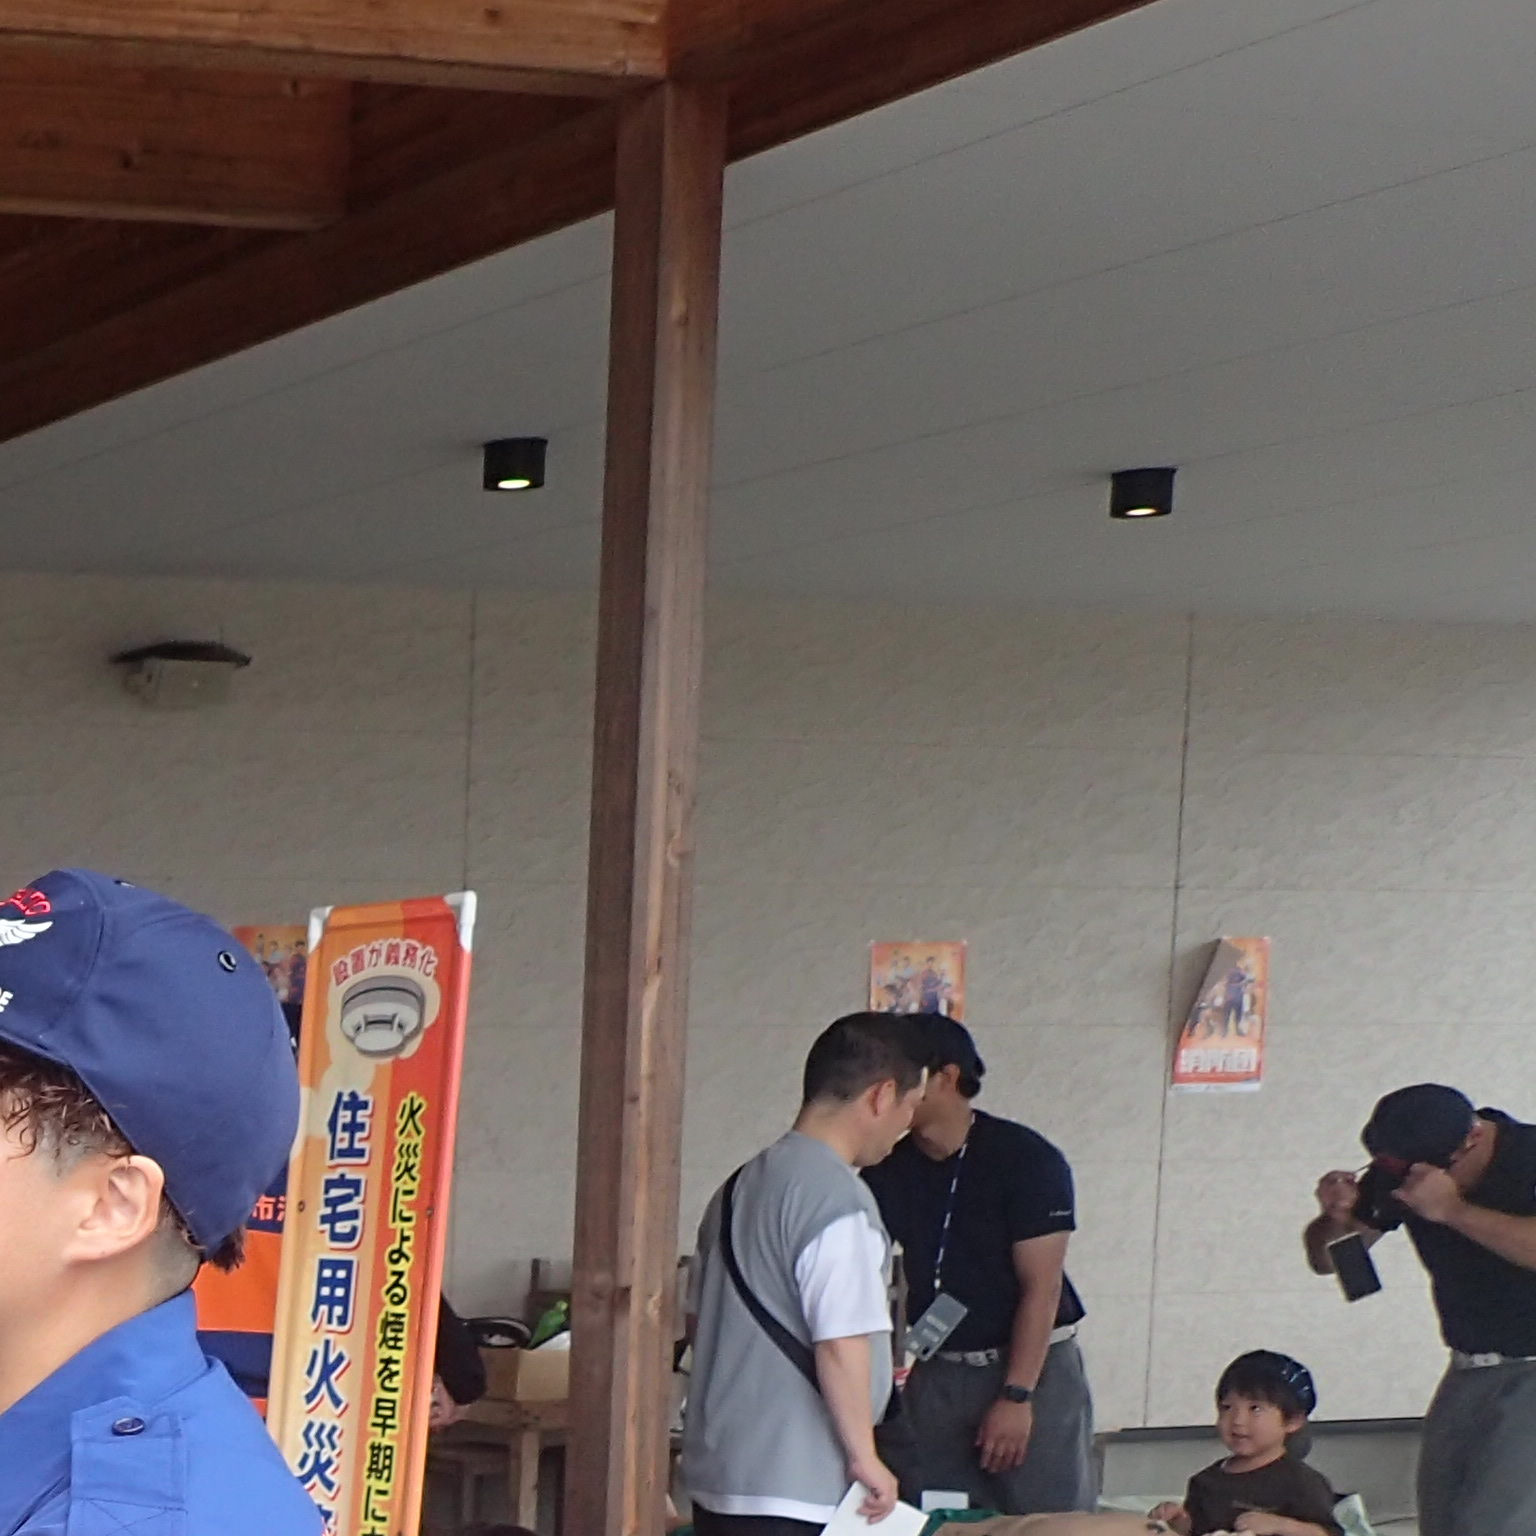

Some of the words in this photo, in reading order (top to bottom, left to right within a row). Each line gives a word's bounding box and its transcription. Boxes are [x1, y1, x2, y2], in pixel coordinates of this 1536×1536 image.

[298, 1090, 372, 1533] 住宅用火災
